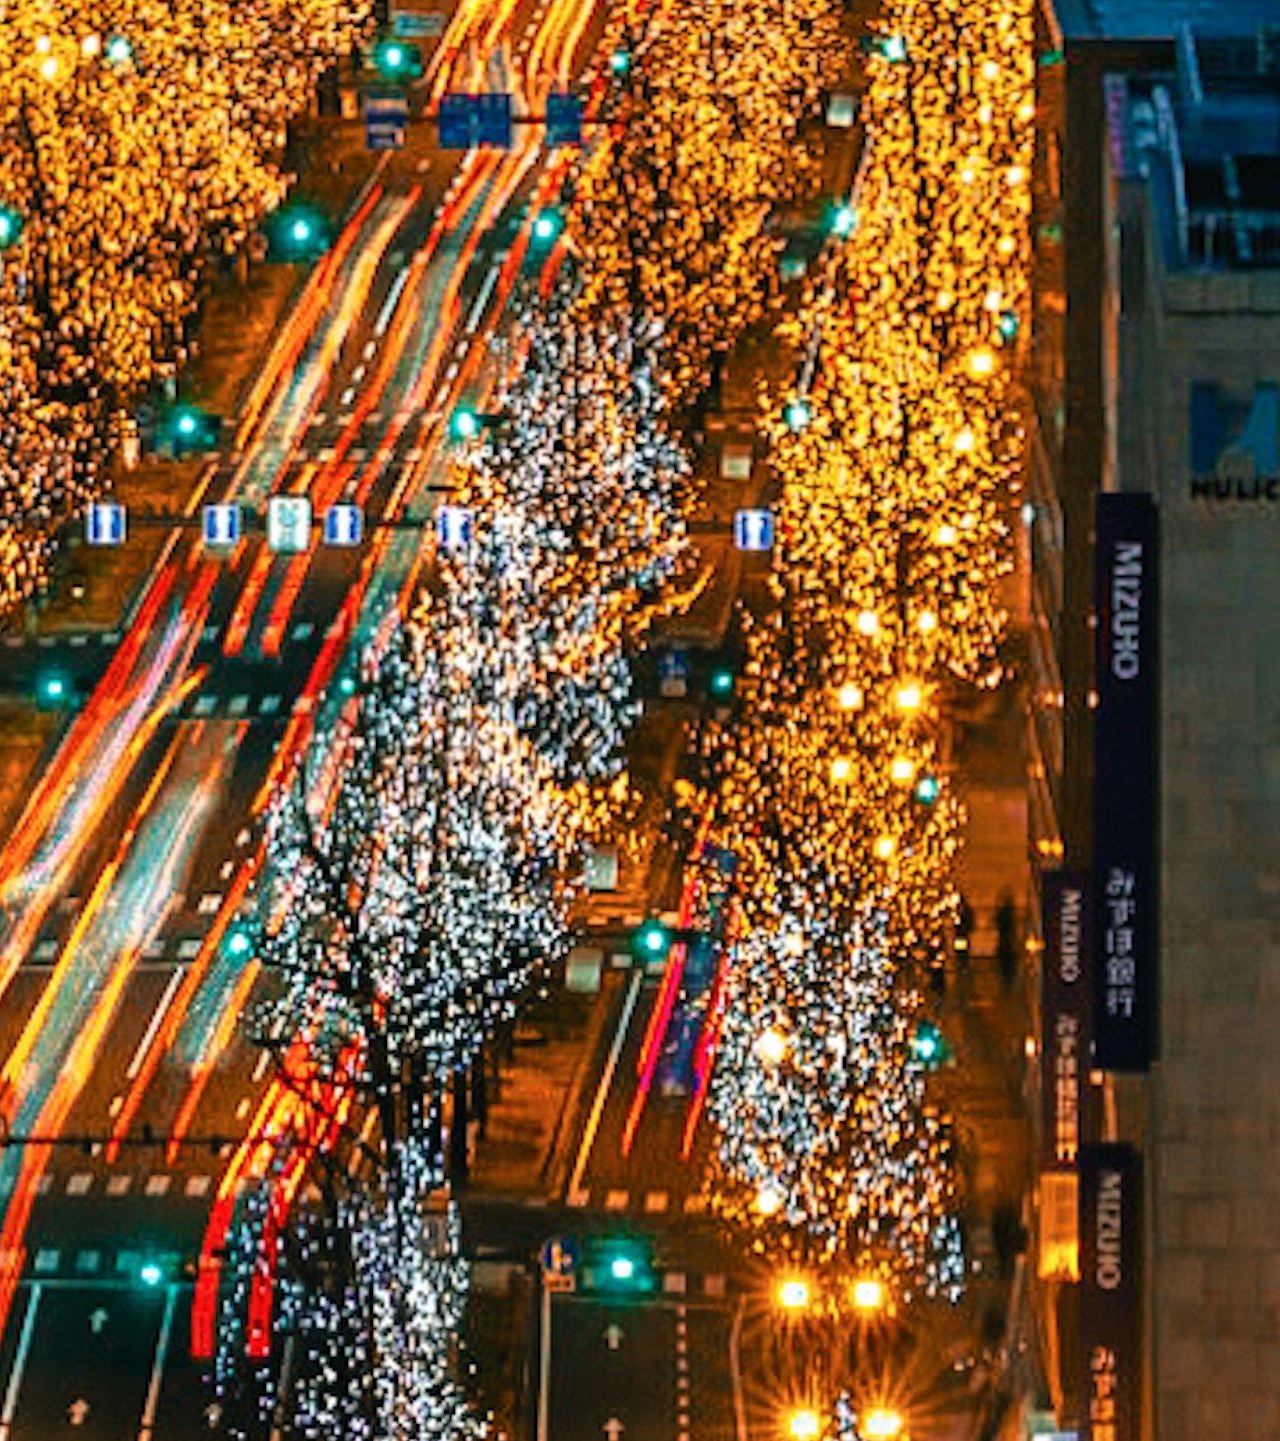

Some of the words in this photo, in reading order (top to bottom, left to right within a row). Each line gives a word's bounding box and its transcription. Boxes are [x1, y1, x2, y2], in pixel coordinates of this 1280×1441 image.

[1111, 540, 1144, 679] MIZUHO
[1060, 889, 1082, 983] MIZUHO
[1105, 866, 1136, 1018] みずほ銀行
[1097, 1171, 1121, 1290] MIZUHO
